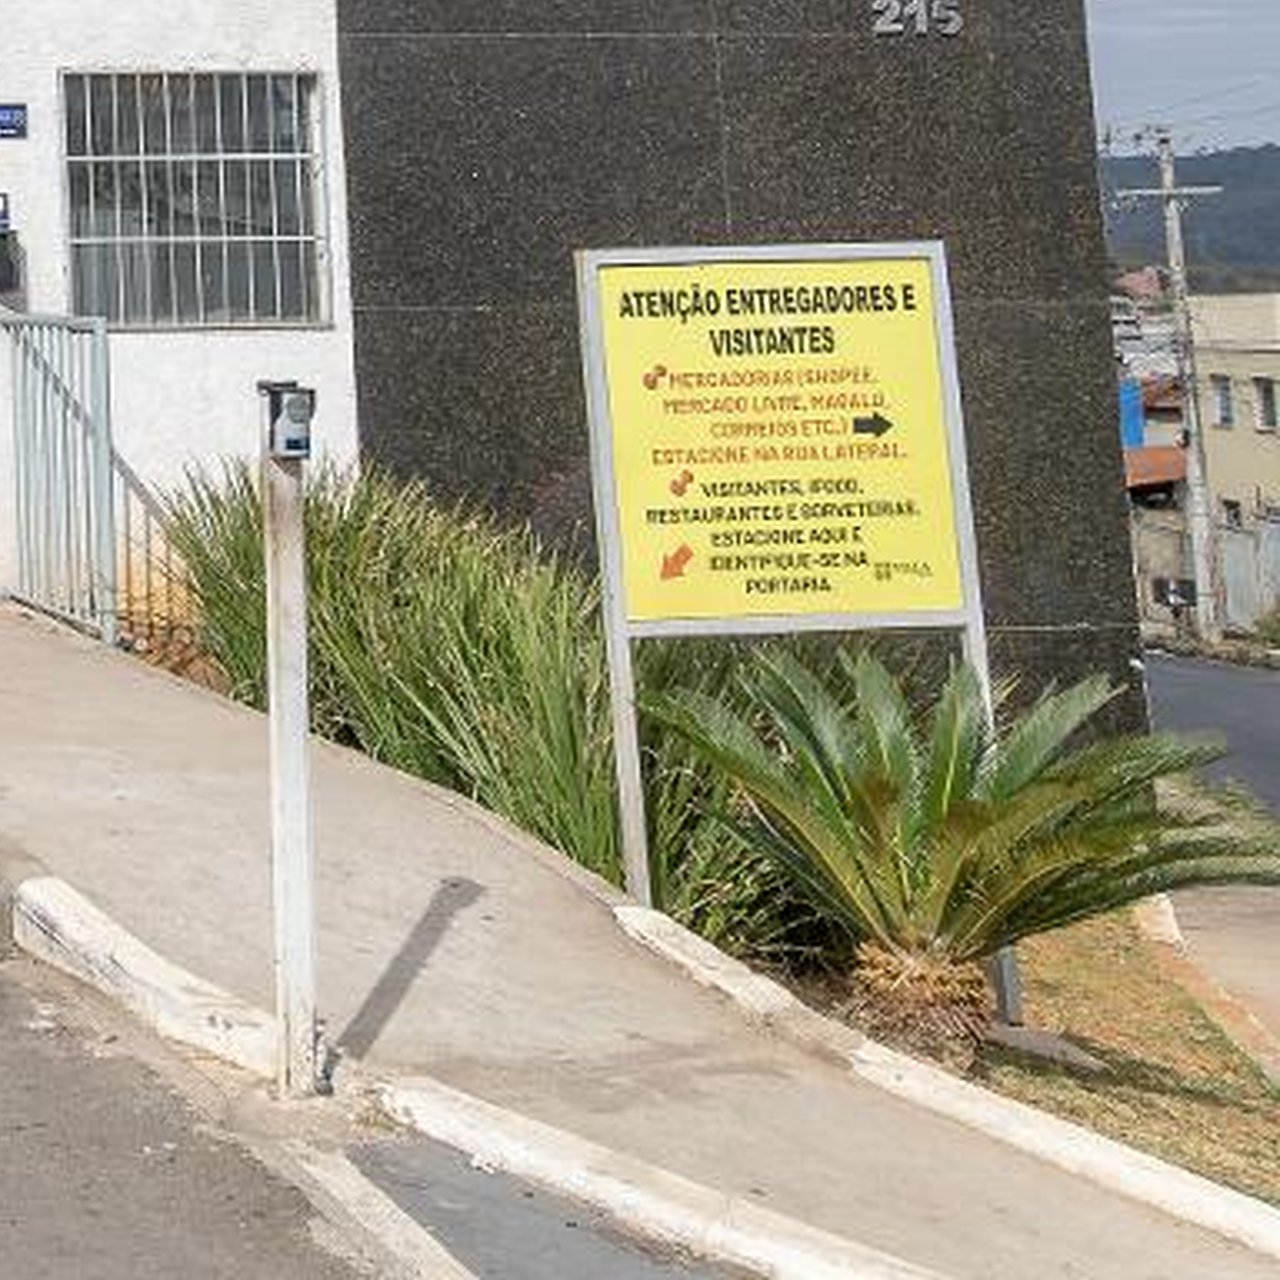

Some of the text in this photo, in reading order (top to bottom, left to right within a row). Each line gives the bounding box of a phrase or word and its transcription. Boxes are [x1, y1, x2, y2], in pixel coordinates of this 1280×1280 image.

[619, 283, 916, 323] ATENÇÃO ENTREGADORES E
[709, 326, 835, 357] VISITANTES
[663, 396, 749, 415] MERCADO
[652, 447, 751, 465] ESTACIONE
[783, 445, 821, 462] RUA
[646, 505, 783, 524] RESTAURANTES
[711, 528, 805, 547] ESTACIONE
[810, 527, 848, 545] AQUI
[842, 551, 870, 567] NA
